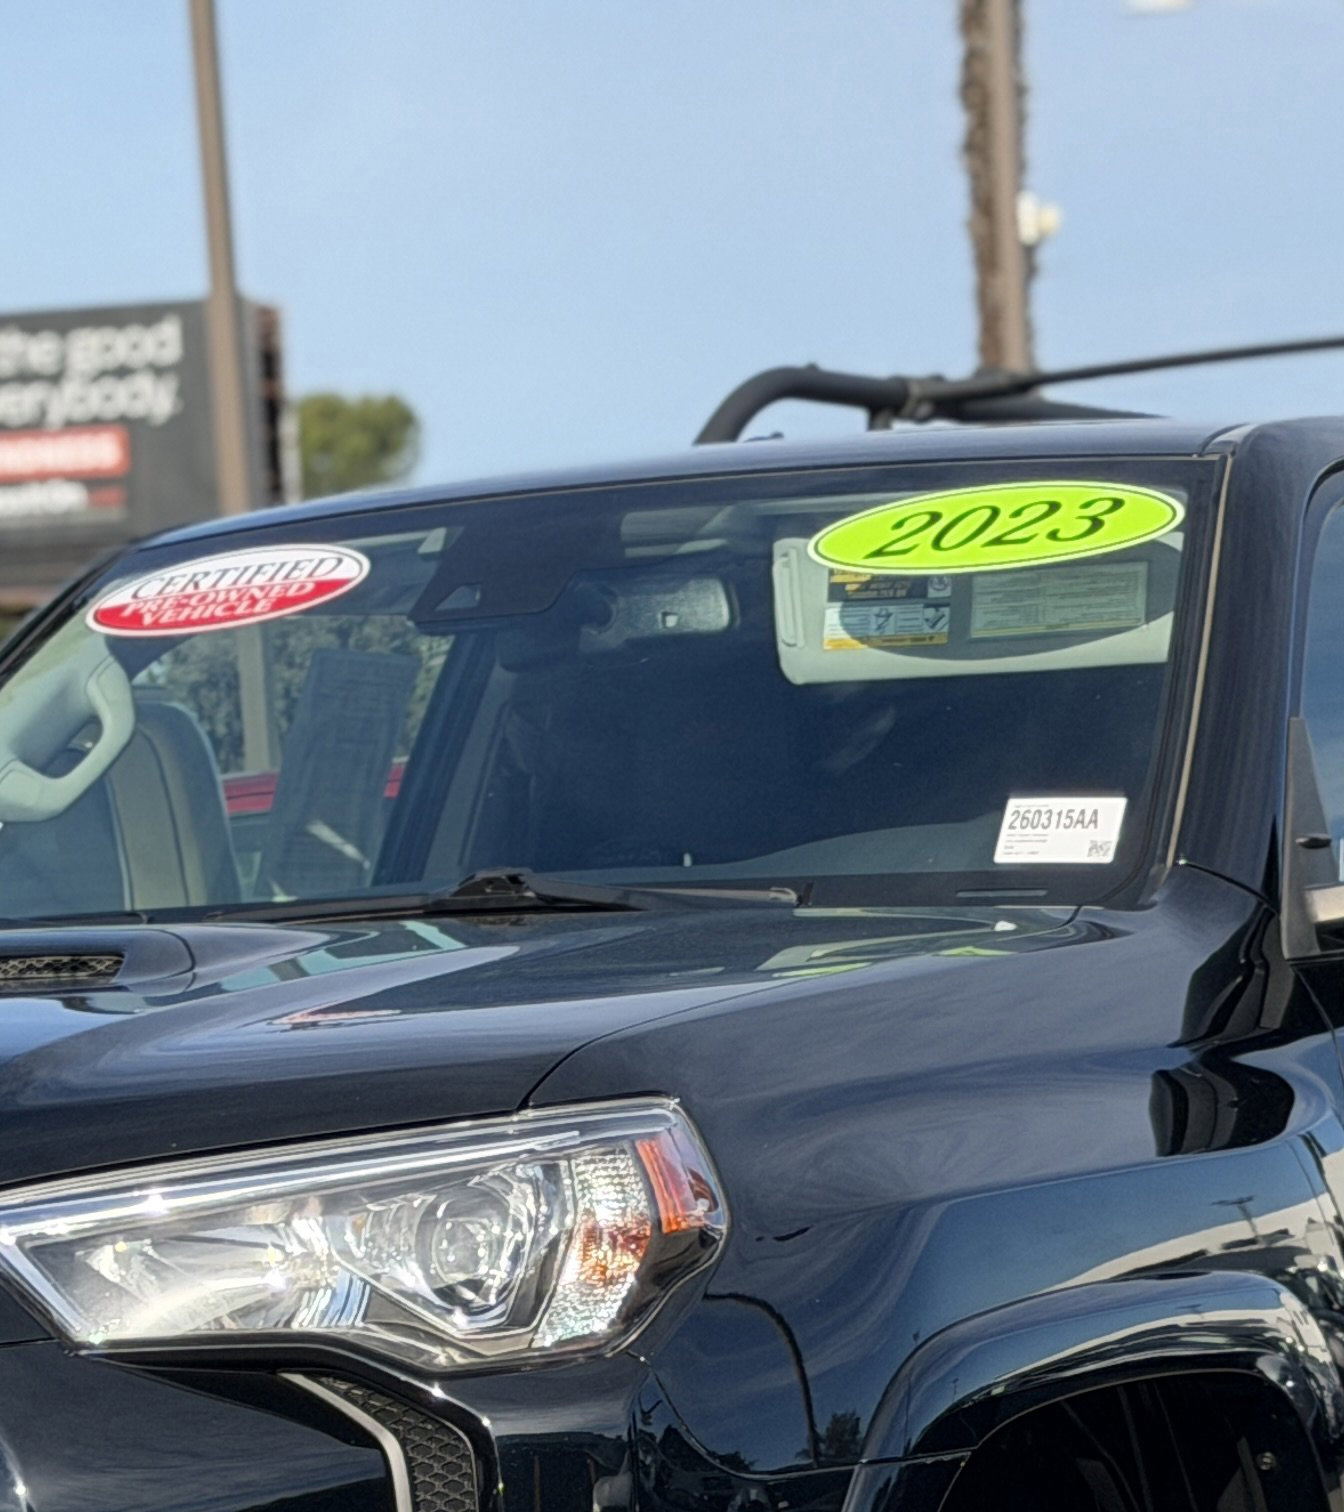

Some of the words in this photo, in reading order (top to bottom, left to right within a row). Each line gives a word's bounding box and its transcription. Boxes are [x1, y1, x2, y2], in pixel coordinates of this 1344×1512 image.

[65, 314, 183, 382] good
[862, 497, 1126, 560] 2023
[132, 557, 343, 600] CERTIFIED
[120, 582, 316, 617] PRE-OWNED
[142, 598, 277, 628] VEHICLE
[1008, 808, 1099, 831] 260315AA
